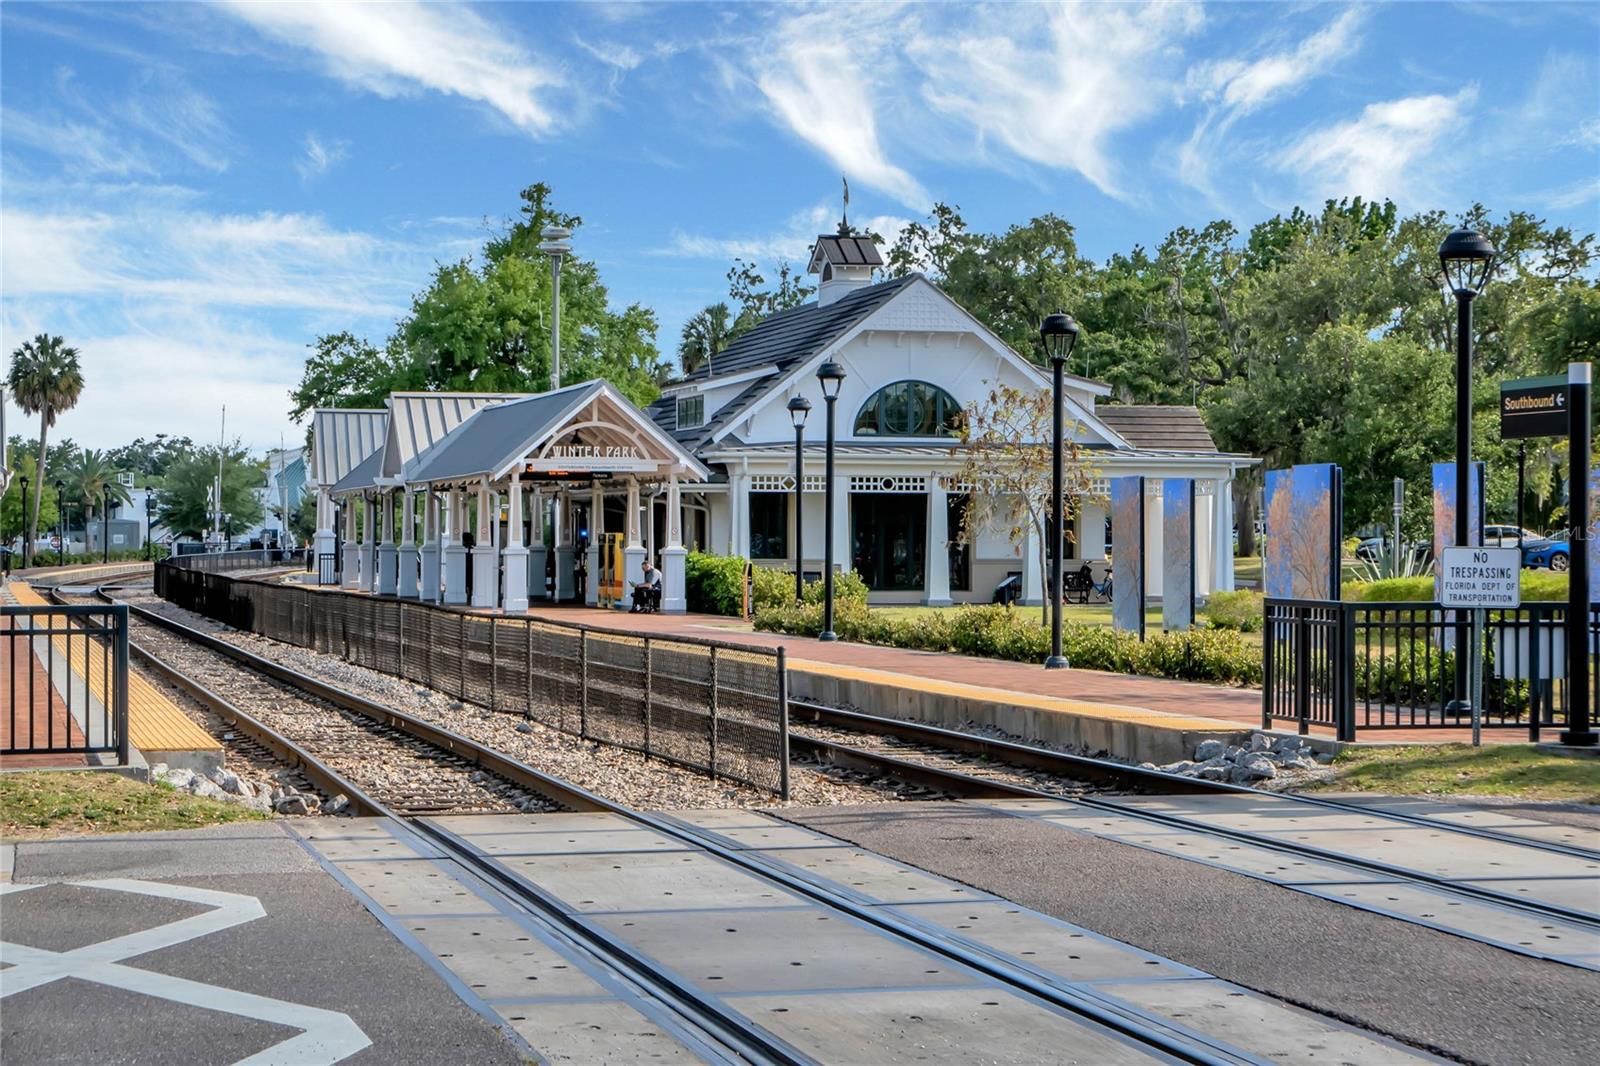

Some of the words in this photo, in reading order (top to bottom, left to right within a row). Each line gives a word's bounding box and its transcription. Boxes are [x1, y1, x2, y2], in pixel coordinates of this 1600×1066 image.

[1504, 393, 1555, 410] Southbound
[552, 446, 601, 458] WINTER
[606, 446, 638, 458] PARK
[1474, 552, 1488, 563] NO
[1450, 567, 1511, 579] TRESPASSING
[1445, 581, 1476, 590] FLORIDA
[1481, 582, 1500, 591] DEPT
[1506, 582, 1516, 591] OF
[1449, 593, 1513, 602] TRANSPORTATION
